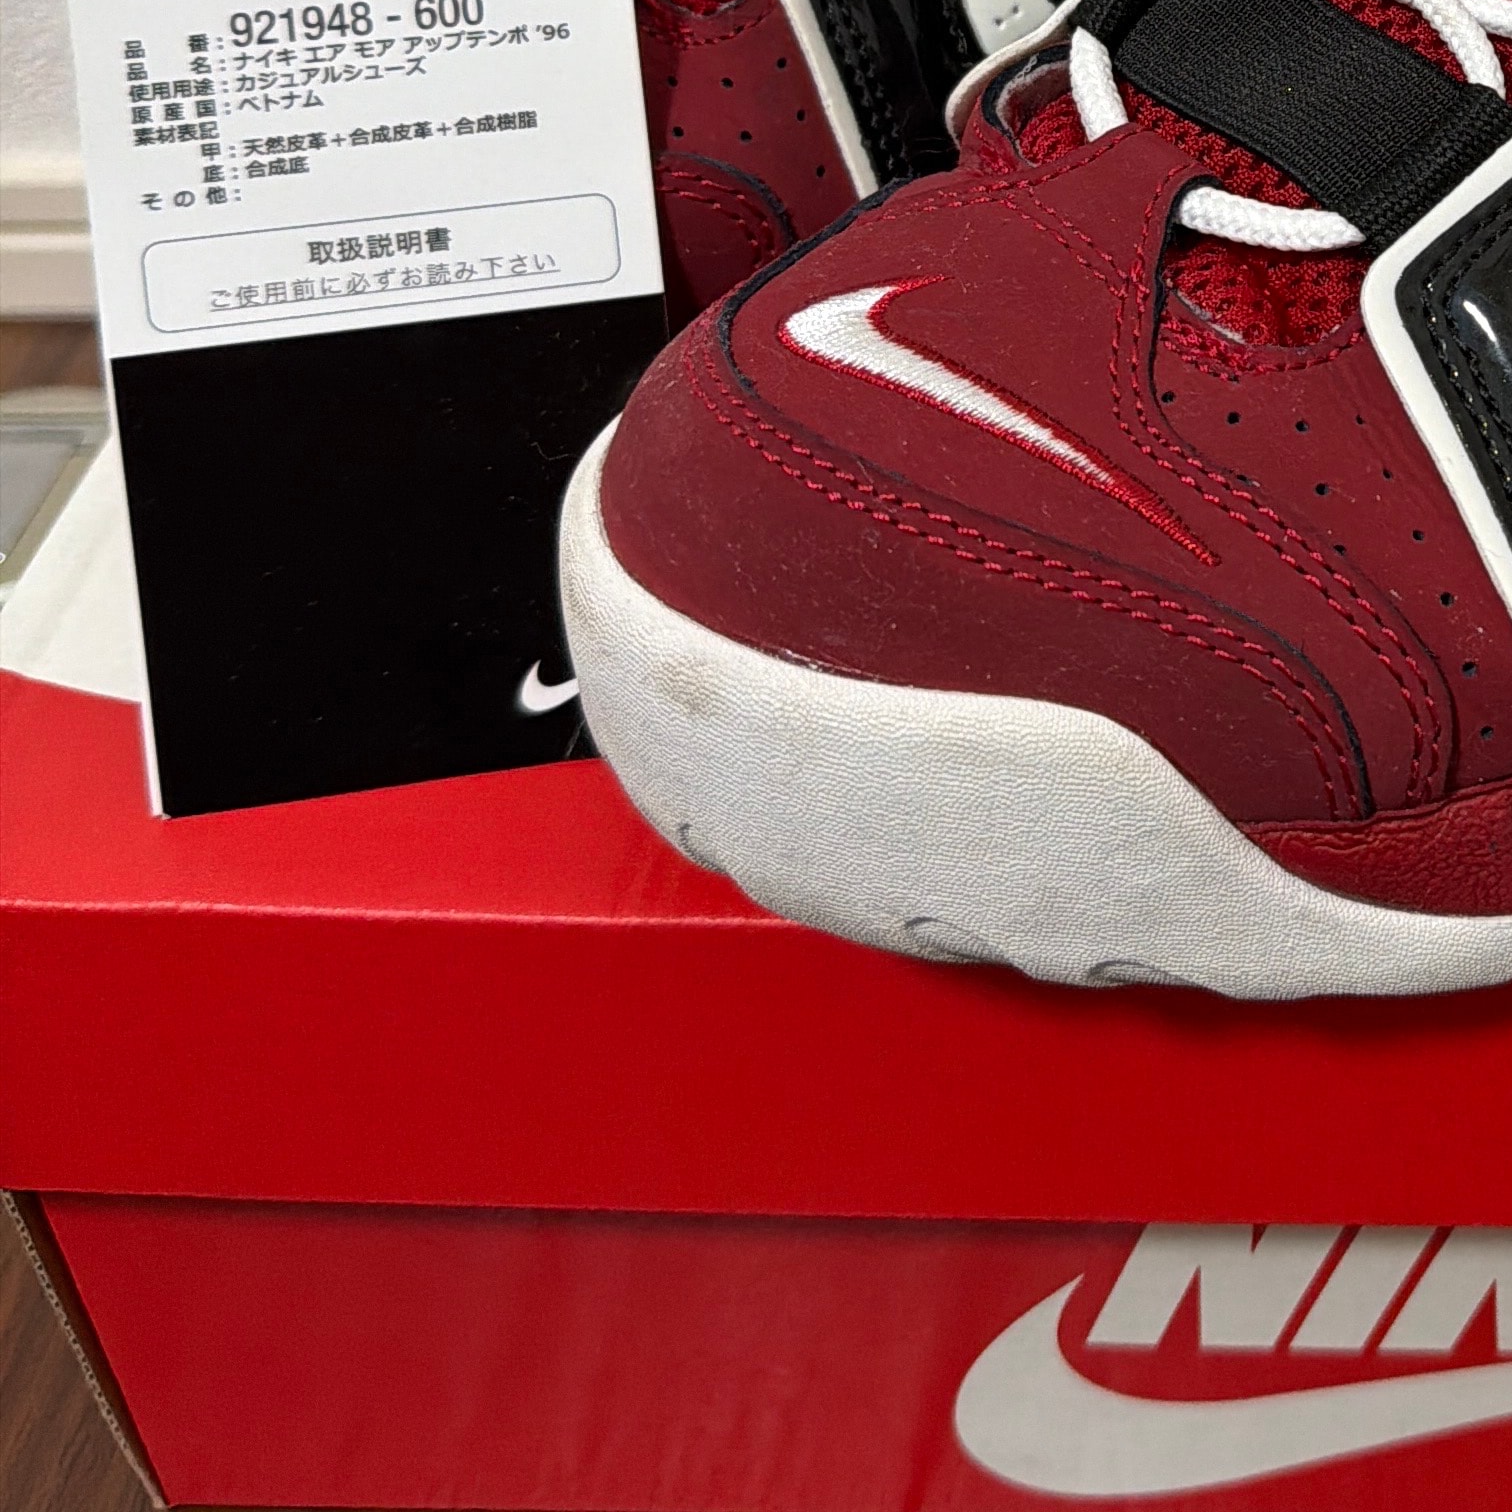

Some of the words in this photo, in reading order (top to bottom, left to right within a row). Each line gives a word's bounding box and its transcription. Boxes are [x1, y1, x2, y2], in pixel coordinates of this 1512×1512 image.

[230, 1, 374, 47] 921948
[238, 90, 325, 113] ベトナム
[132, 121, 220, 147] 素材表記
[246, 156, 310, 179] 合成底
[307, 226, 452, 266] 取扱説明書
[209, 252, 558, 310] ご使用前に必ずお読み下さい
